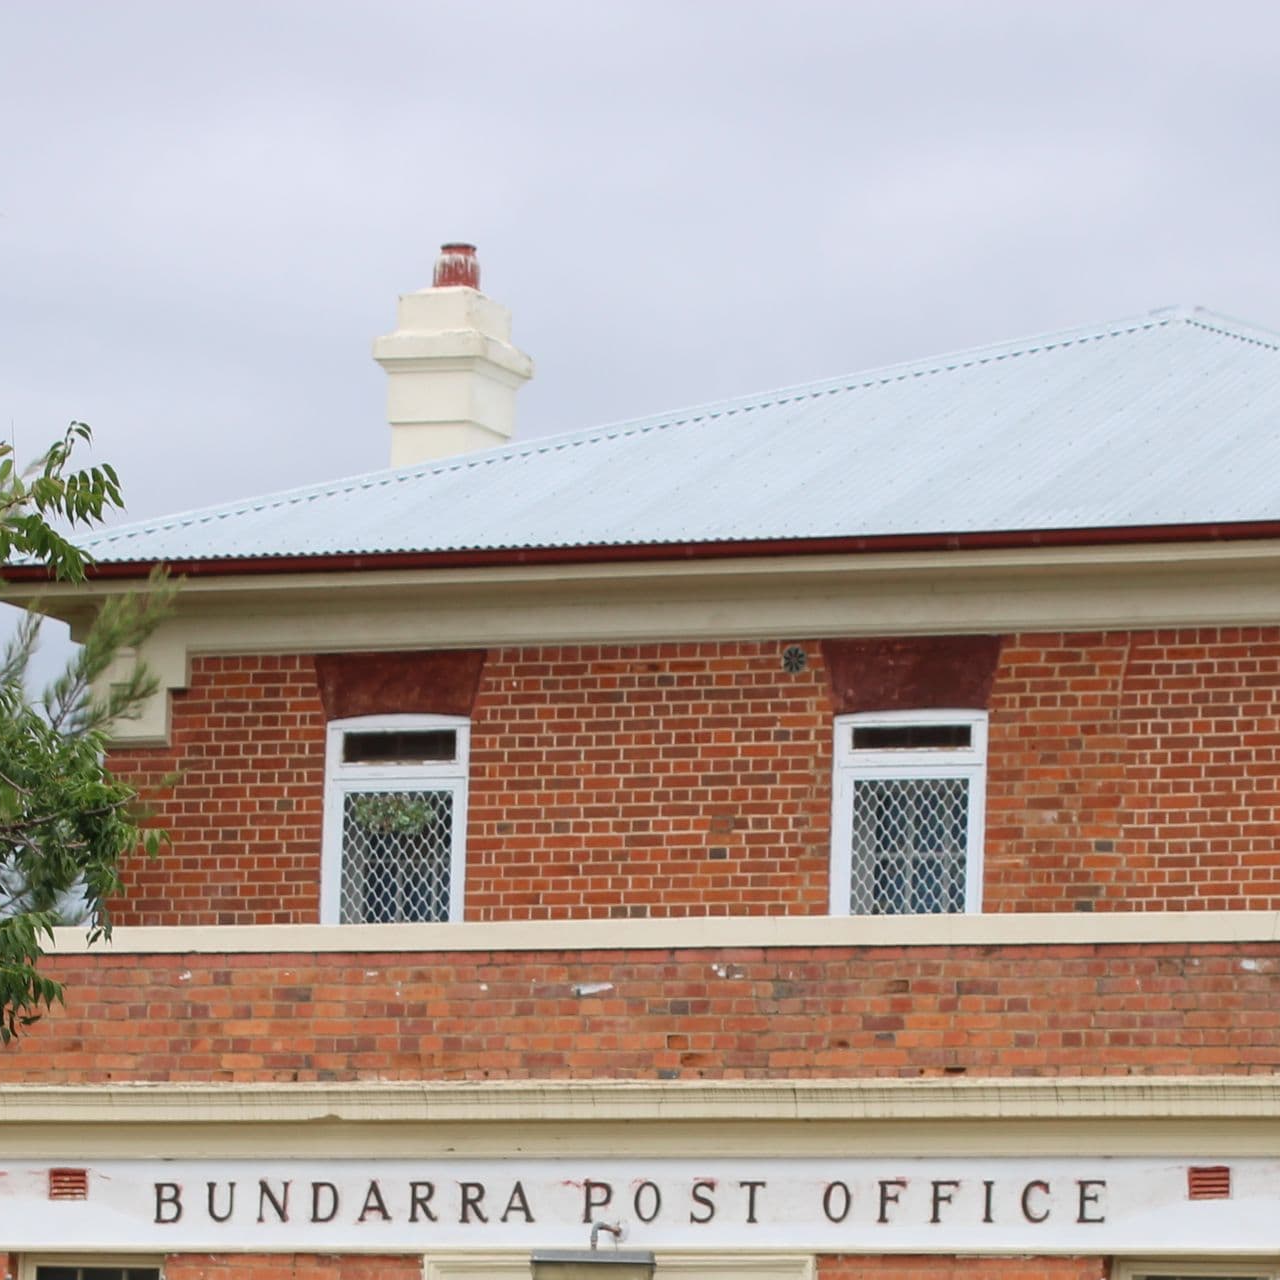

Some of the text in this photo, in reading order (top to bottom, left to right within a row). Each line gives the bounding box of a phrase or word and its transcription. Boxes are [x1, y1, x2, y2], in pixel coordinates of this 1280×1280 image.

[154, 1179, 1108, 1225] BUNDARRA POST OFFICE
